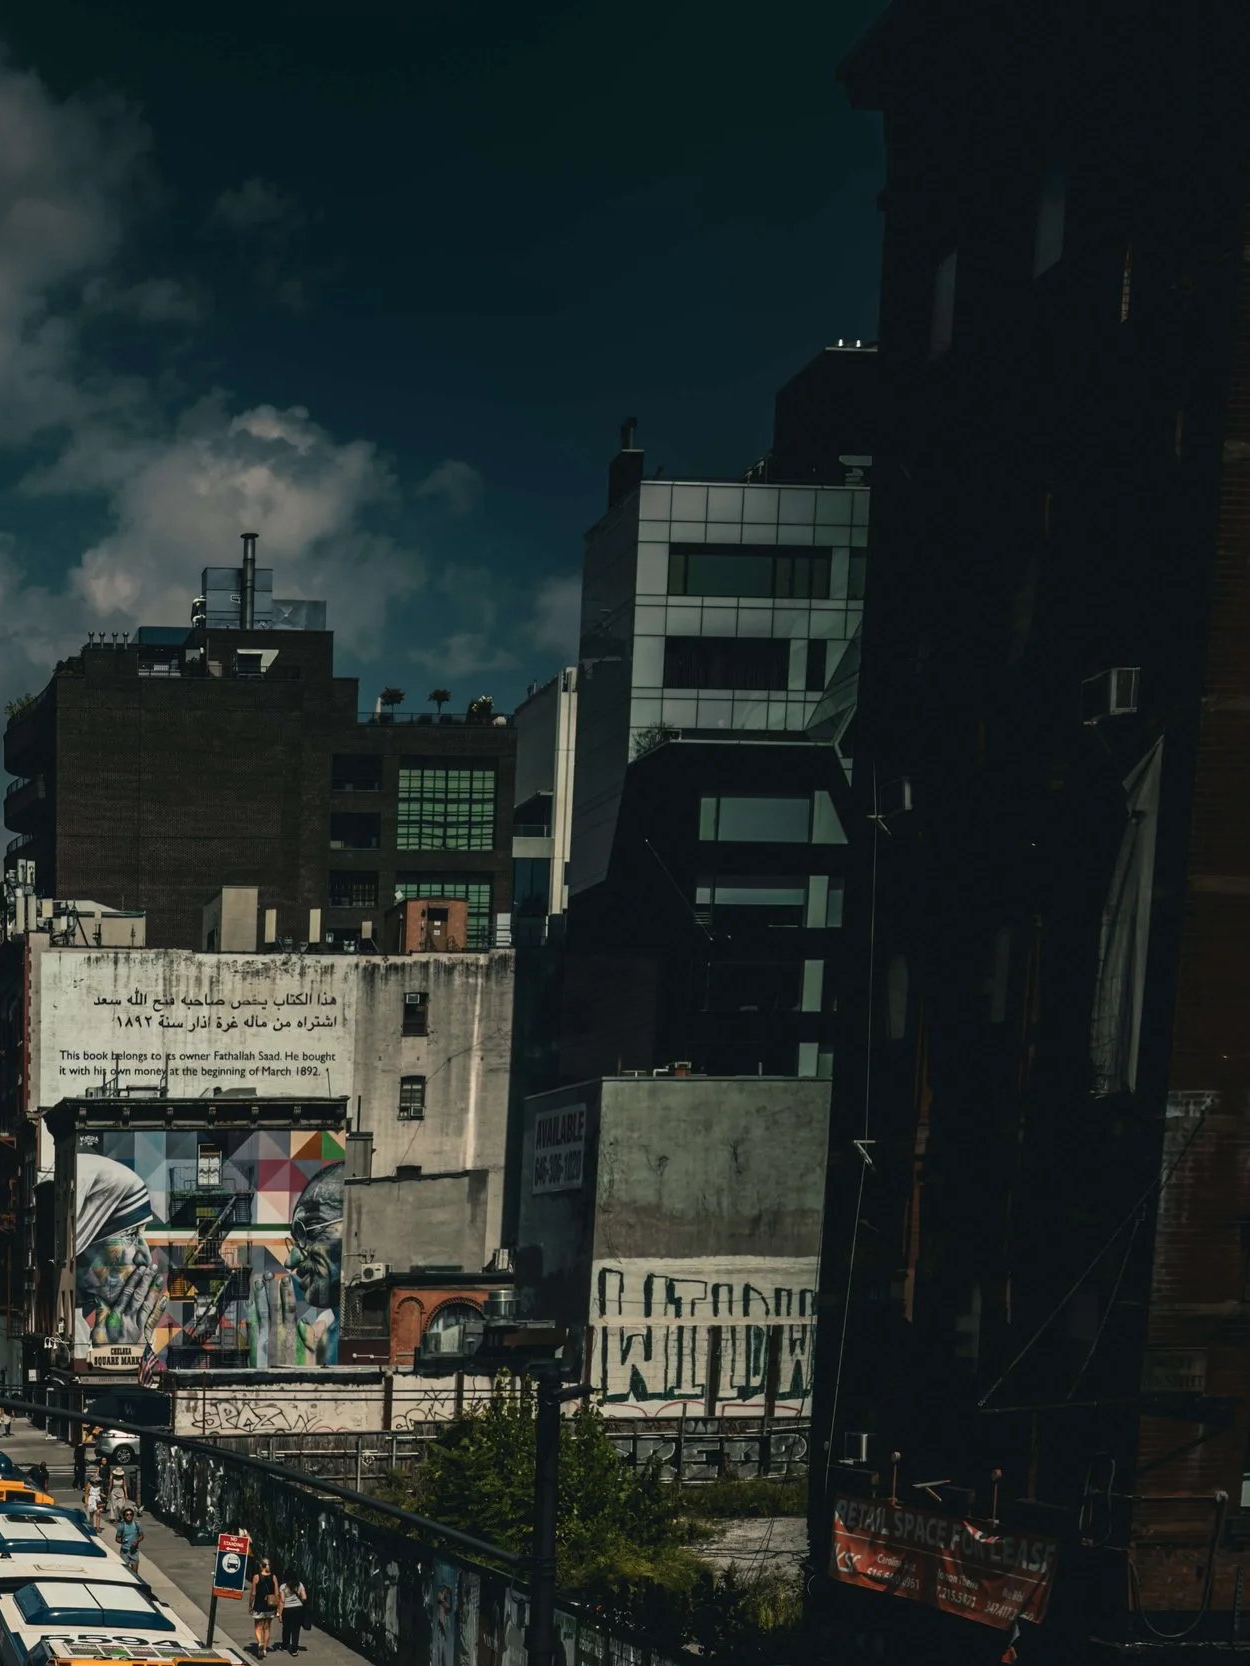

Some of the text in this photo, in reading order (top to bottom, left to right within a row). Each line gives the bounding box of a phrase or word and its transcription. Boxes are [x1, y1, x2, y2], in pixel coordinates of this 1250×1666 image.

[93, 996, 121, 1006] سعد
[127, 987, 147, 1006] الله
[180, 993, 225, 1010] صاحبه
[273, 992, 313, 1011] الكتاب
[317, 991, 337, 1006] هذا
[159, 1014, 184, 1028] سنة
[216, 1016, 239, 1032] غرة
[273, 1017, 292, 1032] من
[297, 1015, 337, 1031] اشتراه
[59, 1050, 80, 1061] This
[83, 1051, 108, 1061] book
[111, 1051, 148, 1063] belongs
[151, 1052, 162, 1061] to
[180, 1053, 211, 1061] owner
[213, 1050, 255, 1061] Fathallah
[258, 1050, 282, 1061] Saad.
[284, 1051, 299, 1061] He
[302, 1051, 336, 1064] bought
[59, 1066, 66, 1076] it
[69, 1066, 90, 1076] with
[93, 1066, 107, 1076] his
[134, 1069, 166, 1079] money
[170, 1068, 180, 1076] at
[182, 1066, 198, 1076] the
[201, 1066, 246, 1079] beginning
[248, 1066, 259, 1076] of
[261, 1066, 291, 1076] March
[296, 1066, 321, 1076] 1892.
[536, 1110, 584, 1150] AVAILABLE
[111, 1347, 132, 1356] CHELSEA
[94, 1356, 120, 1366] SQUARE
[836, 1498, 890, 1535] RETAIL
[894, 1511, 947, 1549] SPACE
